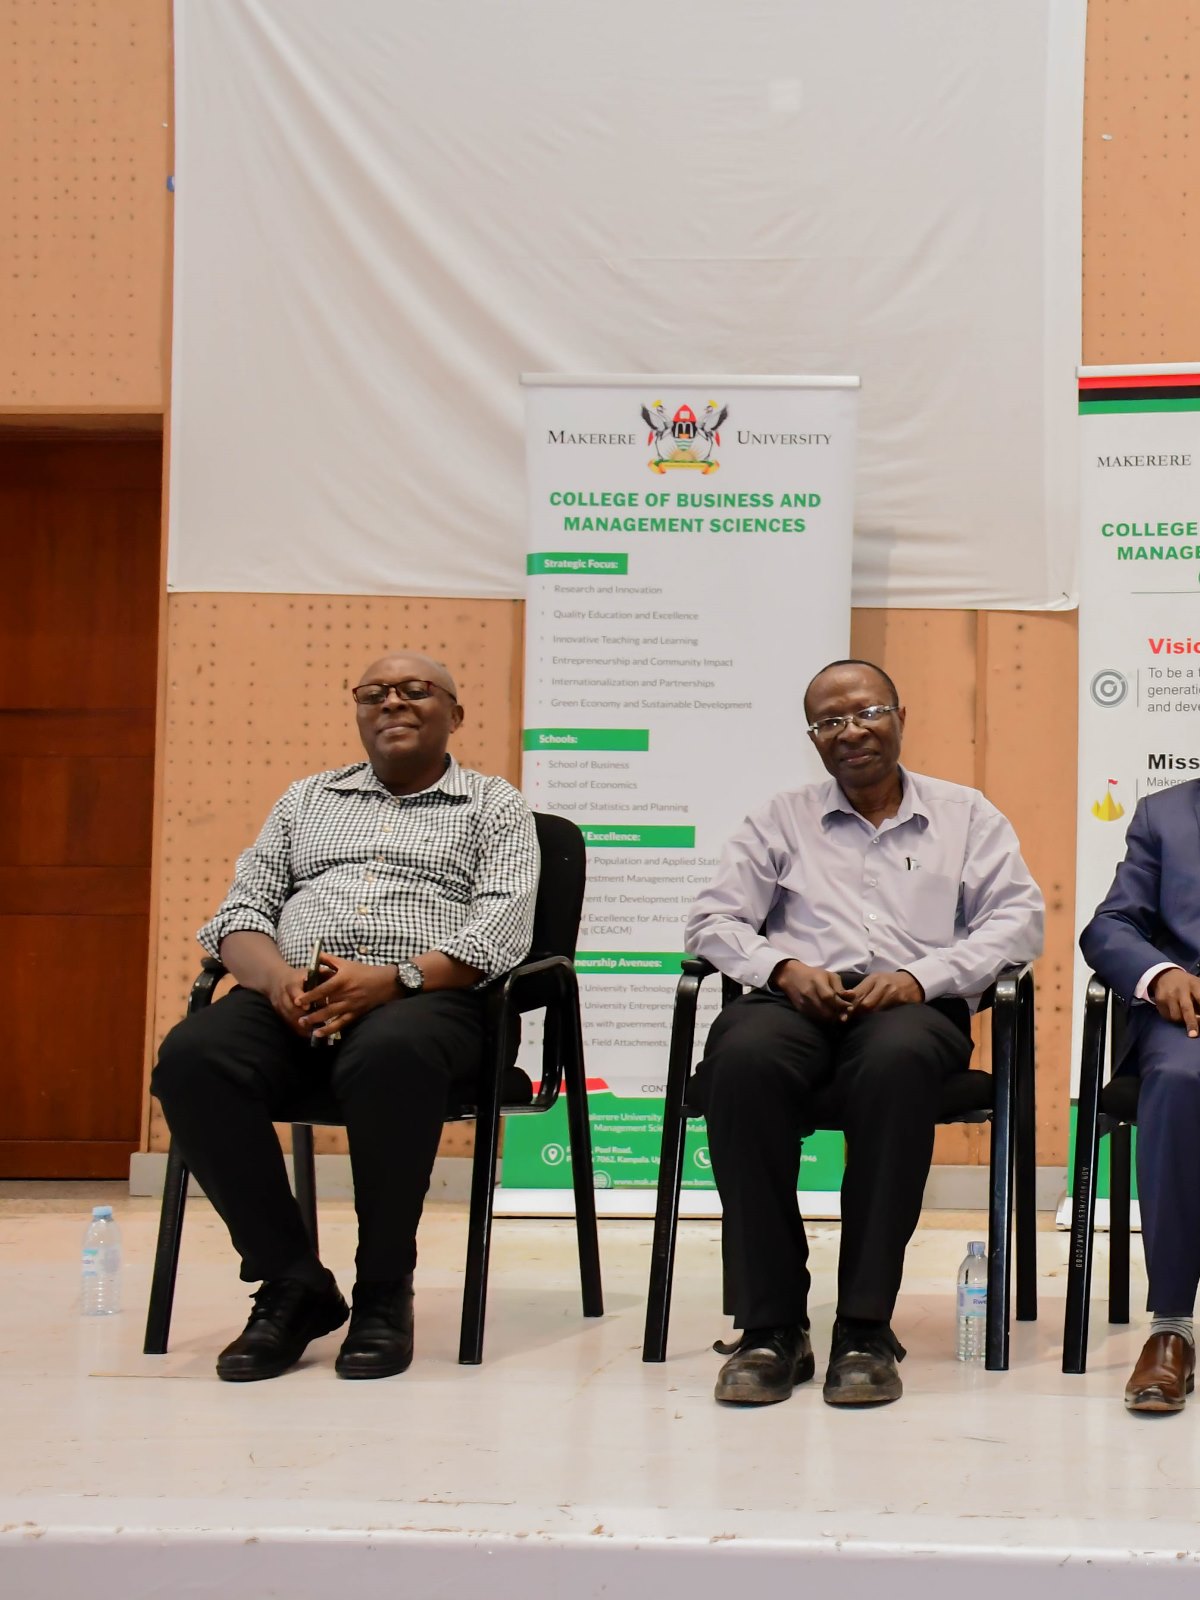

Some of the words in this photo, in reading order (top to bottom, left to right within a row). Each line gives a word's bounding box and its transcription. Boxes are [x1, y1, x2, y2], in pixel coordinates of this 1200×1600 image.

[548, 430, 635, 445] MAKERERE
[737, 431, 831, 445] UNIVERSITY
[1098, 455, 1191, 467] MAKERERE
[550, 492, 639, 507] COLLEGE
[645, 493, 670, 507] OF
[677, 493, 774, 508] BUSINESS
[780, 494, 821, 507] AND
[564, 517, 704, 532] MANAGEMENT
[710, 518, 805, 533] SCIENCES
[1102, 522, 1198, 537] COLLEGE
[544, 559, 587, 569] Strategic
[587, 559, 618, 568] Focus:
[554, 585, 595, 593] Research
[615, 586, 662, 594] Innovation
[553, 610, 586, 619] Quality
[588, 610, 633, 619] Education
[634, 611, 651, 619] and
[652, 611, 699, 620] Excellence
[553, 635, 599, 643] Innovative
[601, 636, 640, 646] Teaching
[642, 636, 659, 644] and
[660, 636, 698, 646] Learning
[552, 656, 630, 666] Entrepreneurship
[649, 657, 702, 667] Community
[704, 659, 733, 667] Impact
[1148, 667, 1162, 678] To
[1167, 667, 1182, 678] be
[1186, 670, 1193, 678] a
[552, 678, 640, 687] Internationalization
[641, 679, 657, 687] and
[659, 679, 715, 688] Partnerships
[551, 699, 578, 707] Green
[580, 699, 621, 709] Economy
[623, 700, 639, 708] and
[641, 700, 693, 708] Sustainable
[693, 700, 752, 710] Development
[1148, 701, 1170, 712] and
[539, 734, 578, 743] Schools:
[548, 760, 578, 768] School
[591, 761, 629, 769] Business
[548, 780, 577, 788] School
[578, 780, 589, 788] of
[590, 780, 637, 789] Economics
[546, 802, 576, 811] School
[577, 802, 588, 810] of
[589, 802, 630, 811] Statistics
[632, 803, 648, 811] and
[650, 803, 688, 813] Planning
[587, 831, 640, 841] Excellence:
[594, 857, 642, 866] Population
[662, 857, 696, 866] Applied
[626, 874, 684, 884] Management
[687, 875, 712, 883] Centr
[604, 894, 617, 903] for
[618, 895, 678, 904] Development
[588, 914, 635, 922] Excellence
[590, 926, 632, 935] (CEACM)
[618, 958, 662, 967] Avenues:
[584, 984, 628, 993] University
[630, 985, 676, 994] Technology
[584, 1002, 627, 1010] University
[703, 1003, 719, 1011] and
[592, 1038, 613, 1046] Field
